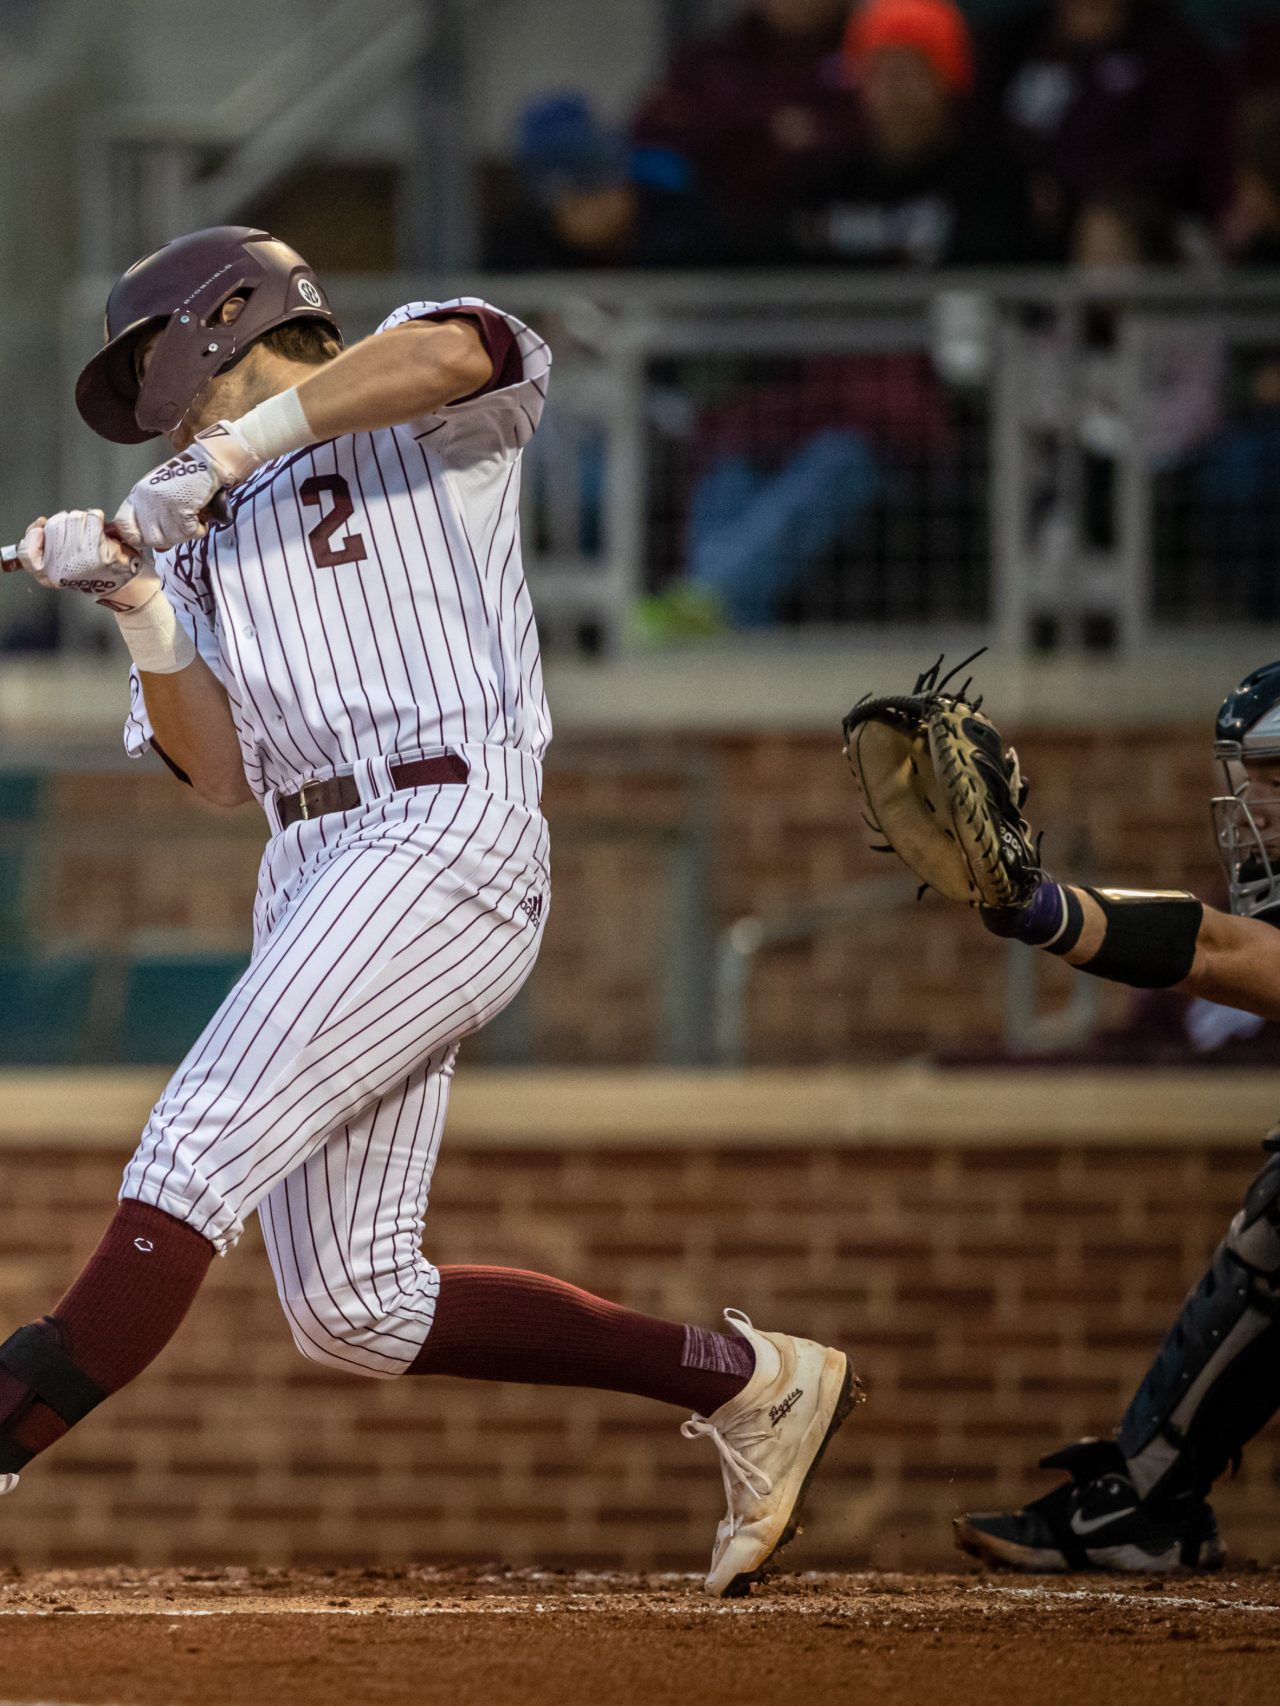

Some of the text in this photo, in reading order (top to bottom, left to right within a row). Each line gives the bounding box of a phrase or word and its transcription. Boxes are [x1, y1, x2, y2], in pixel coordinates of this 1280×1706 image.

[149, 461, 208, 485] adidas
[299, 473, 368, 569] 2
[59, 578, 116, 590] adidas
[768, 1387, 803, 1428] Aggies
